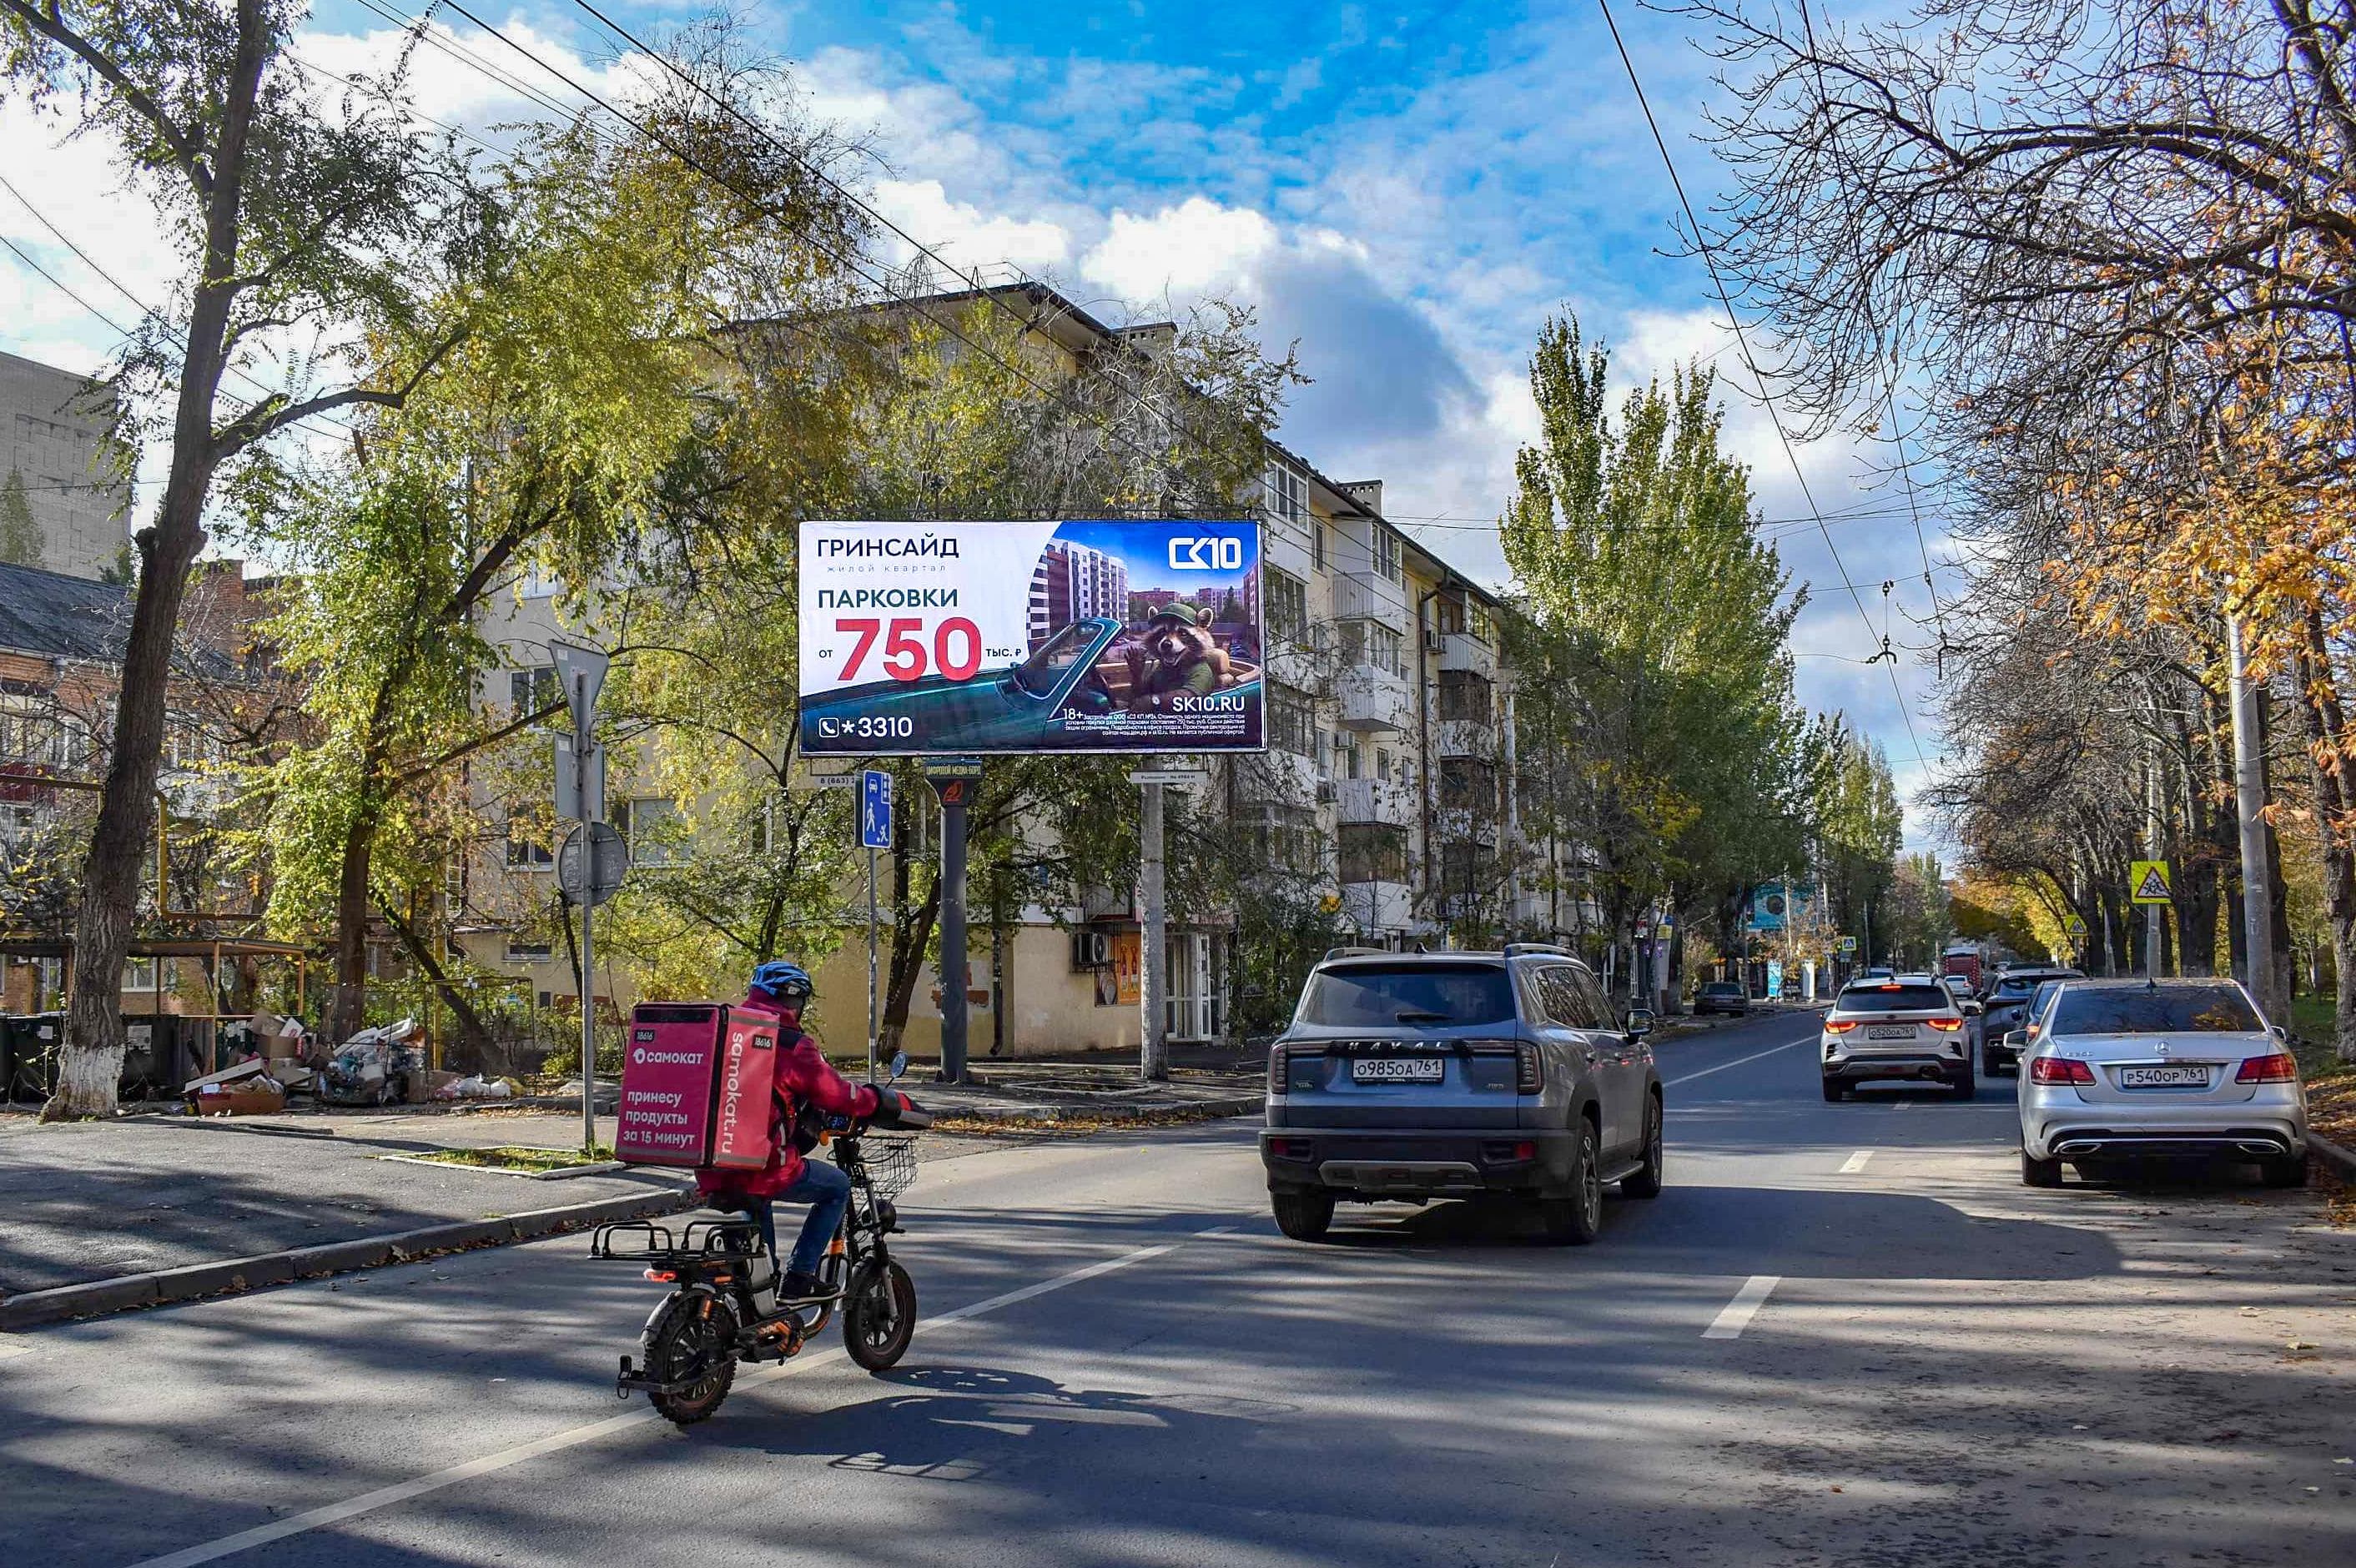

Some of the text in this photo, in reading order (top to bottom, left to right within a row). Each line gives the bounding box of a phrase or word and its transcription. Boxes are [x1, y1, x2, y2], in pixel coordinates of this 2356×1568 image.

[818, 532, 959, 558] ГРИНСАЙД
[827, 564, 945, 573] жилой квартал
[818, 589, 958, 608] ПАРКОВКИ
[836, 616, 982, 681] 750
[1172, 696, 1245, 711] SK10.RU
[1063, 708, 1084, 720] 18+
[1347, 1041, 1442, 1050] HAVAL
[647, 1052, 704, 1064] самокат
[2182, 1068, 2204, 1079] 761
[627, 1090, 682, 1107] принесу
[721, 1032, 745, 1154] samokat.ru
[625, 1110, 687, 1127] продукты
[622, 1131, 695, 1146] за 15 минут
